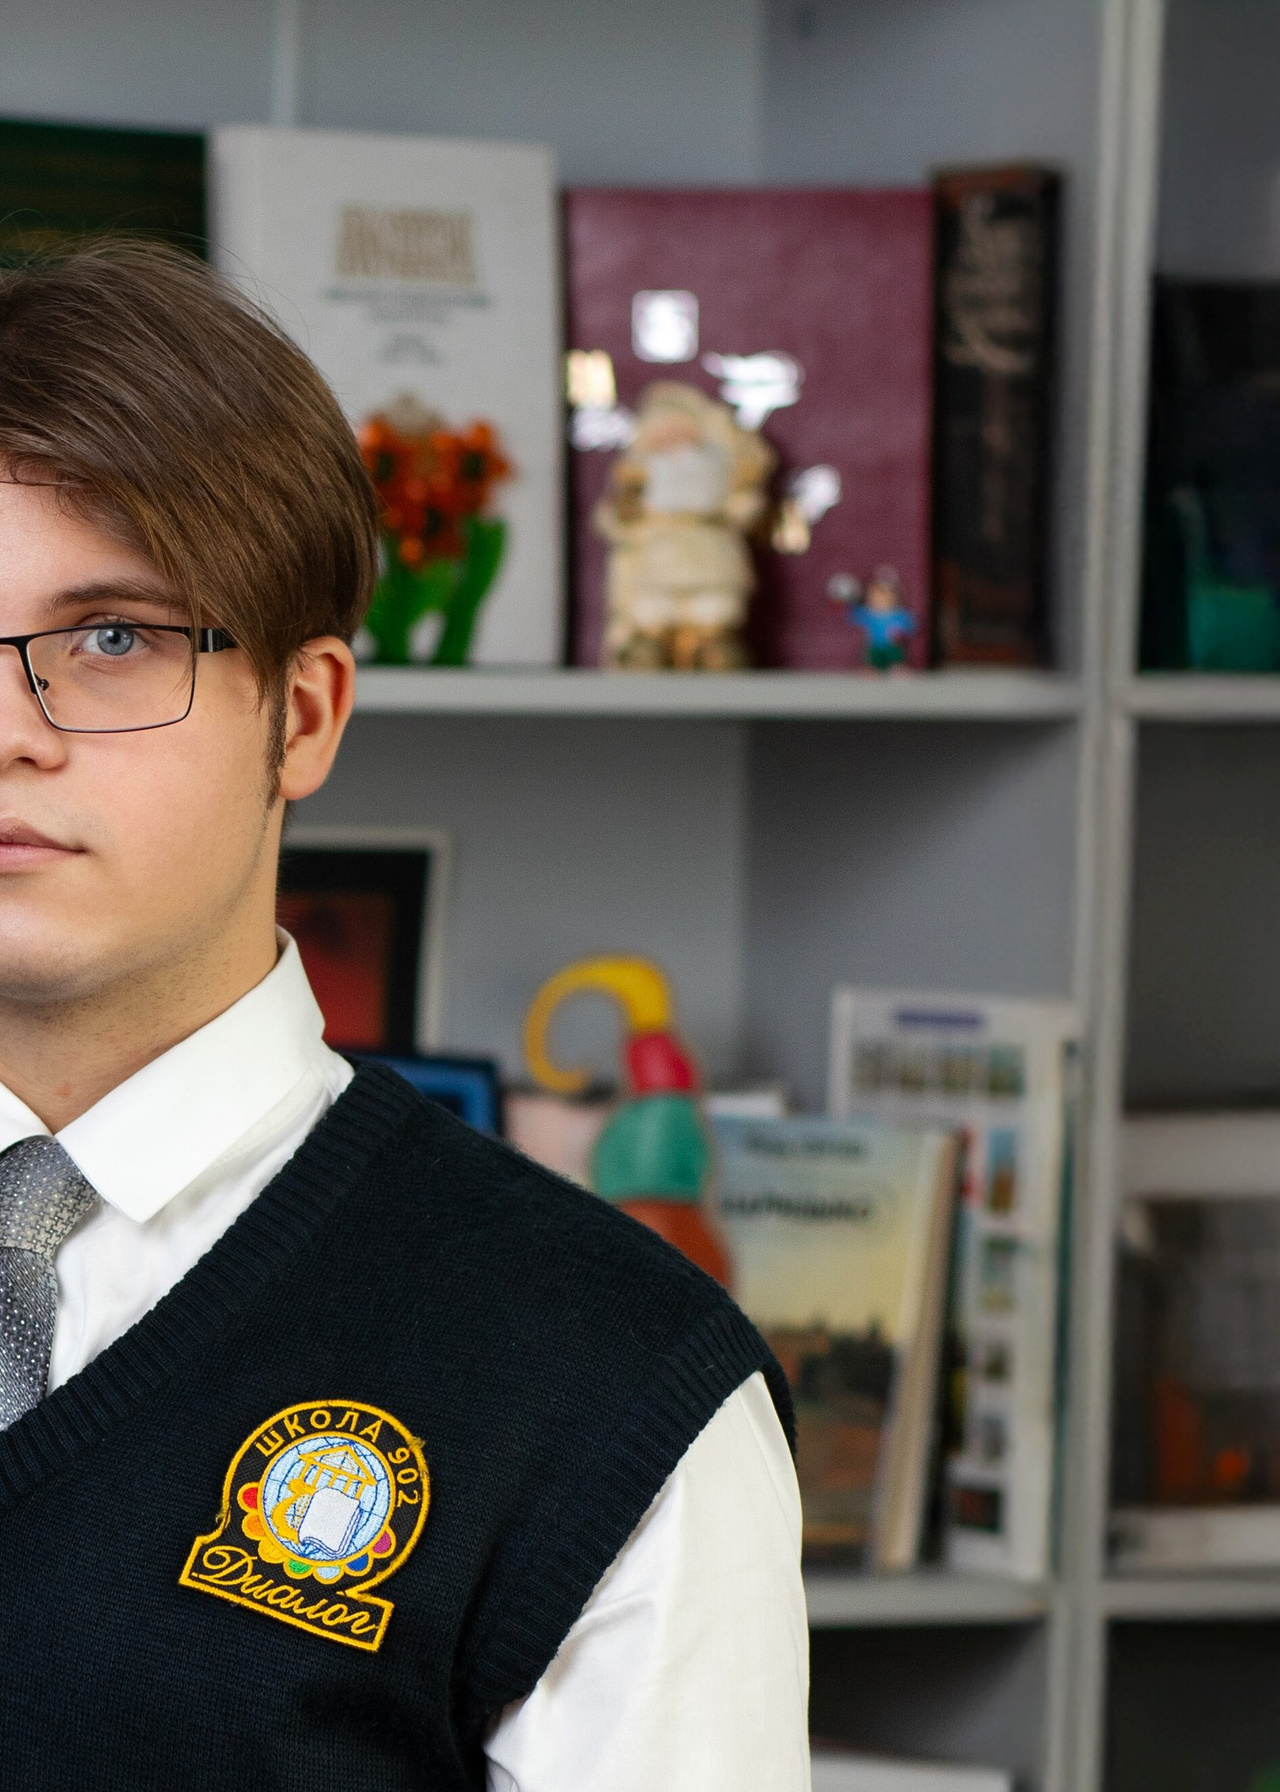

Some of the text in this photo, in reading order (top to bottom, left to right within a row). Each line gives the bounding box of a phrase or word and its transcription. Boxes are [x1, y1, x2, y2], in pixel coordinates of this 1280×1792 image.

[254, 1409, 420, 1507] ШКОЛА 902
[191, 1545, 380, 1635] Диалог
